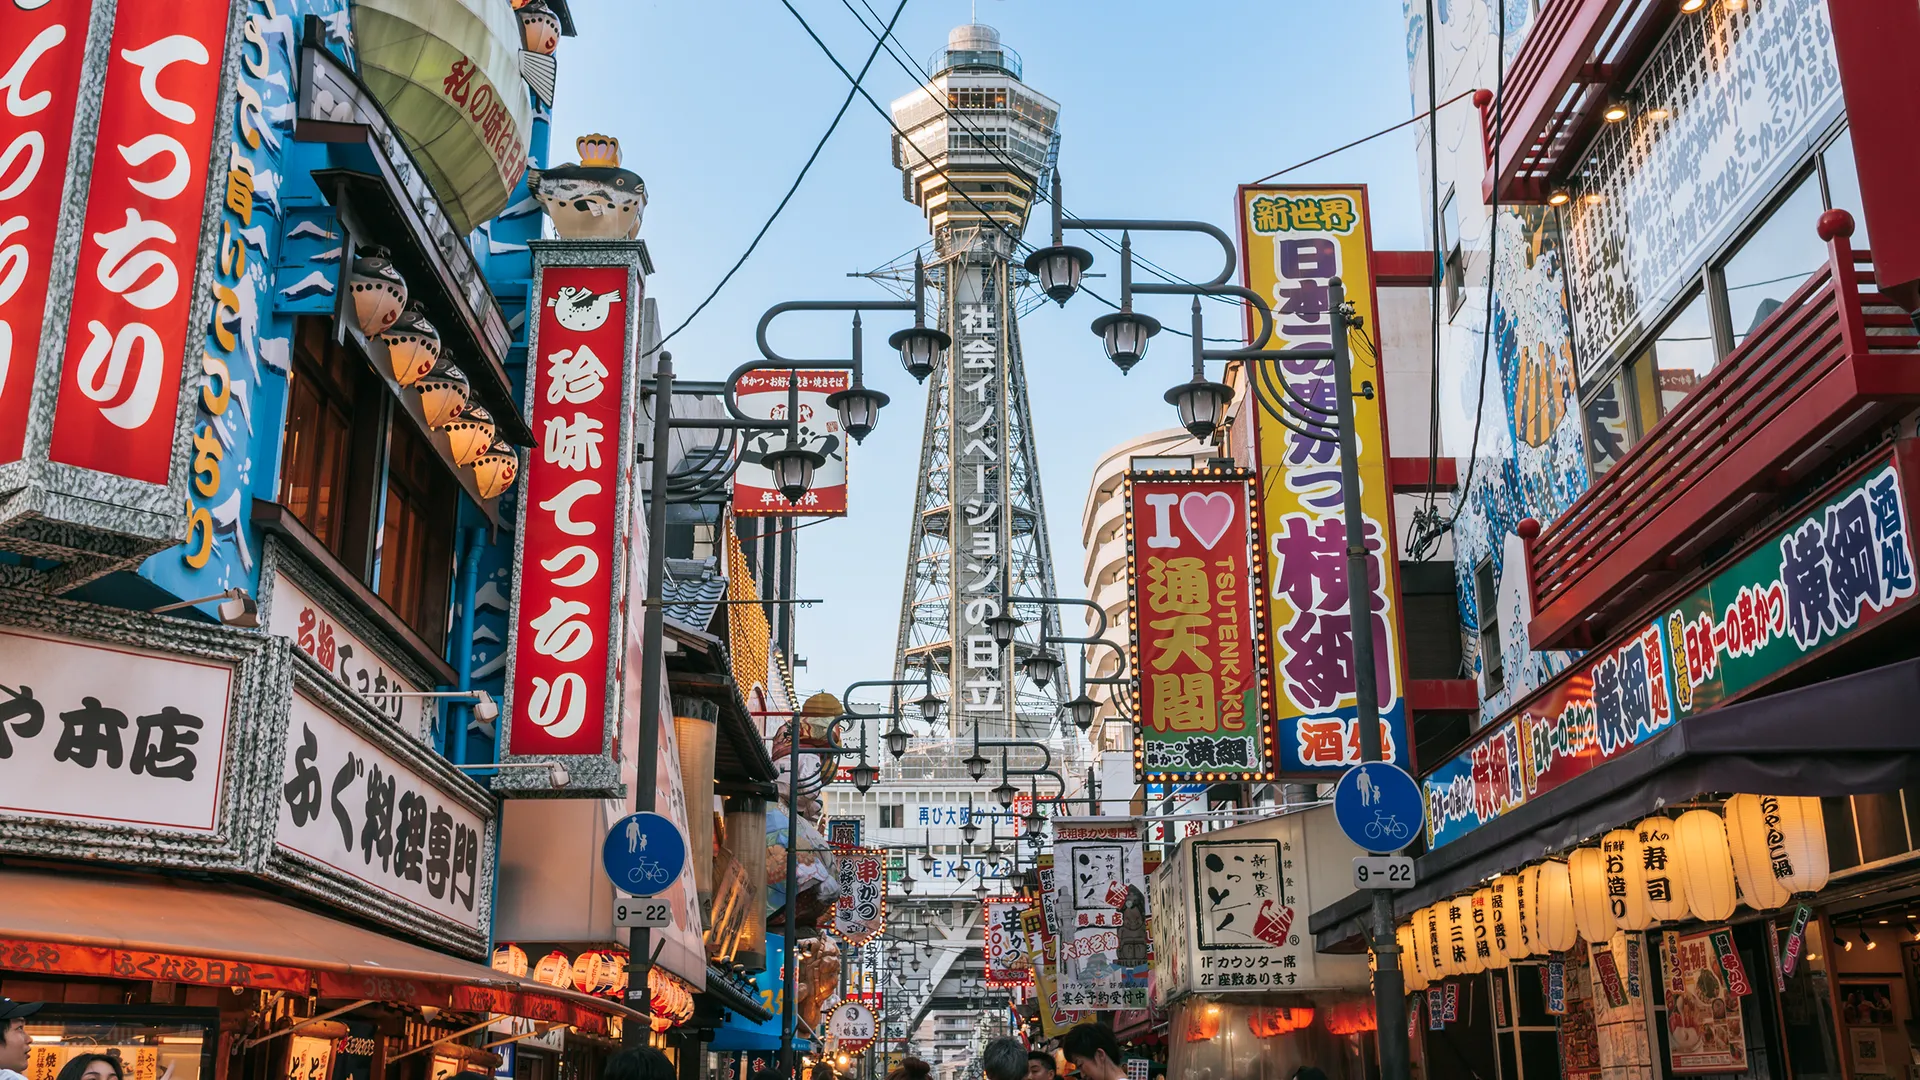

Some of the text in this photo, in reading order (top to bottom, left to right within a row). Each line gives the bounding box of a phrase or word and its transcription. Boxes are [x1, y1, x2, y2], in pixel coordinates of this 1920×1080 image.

[1734, 56, 1763, 177] たこ
[1745, 41, 1775, 165] いか
[1768, 9, 1800, 136] ホルモン
[1724, 69, 1752, 189] サーモン
[77, 35, 209, 429] てっちり
[1254, 198, 1355, 232] 新世界
[1570, 274, 1589, 373] もち
[1593, 246, 1612, 347] にんにく
[528, 344, 608, 739] 珍味てっちり
[961, 305, 1003, 712] 社会イノベーションの日立
[1277, 517, 1391, 709] 横綱
[1671, 473, 1913, 705] 新世界 日本一の串かつ 横綱 酒処
[1147, 556, 1216, 732] 通天閣
[1216, 556, 1245, 728] TSUTENKAKU
[1184, 738, 1248, 767] 横綱
[1533, 704, 1595, 772] 日本一の串かつ
[1593, 645, 1649, 752] 横綱
[284, 721, 478, 912] ふぐ料理専門
[1057, 827, 1138, 839] 元祖串カツ専門店
[1761, 797, 1794, 879] ちゃんこ鍋
[857, 859, 878, 920] 串かつ
[1606, 855, 1627, 919] お造り
[1643, 846, 1671, 902] 寿司
[0, 944, 60, 970] らや
[114, 954, 274, 985] ふぐなら日本一
[1002, 906, 1027, 963] 串かつ
[1201, 956, 1297, 968] 1F カウンター席
[1201, 973, 1298, 987] 2F 座敷あります
[1473, 908, 1490, 958] もつ鍋
[1062, 991, 1146, 1006] 宴会予約受付中
